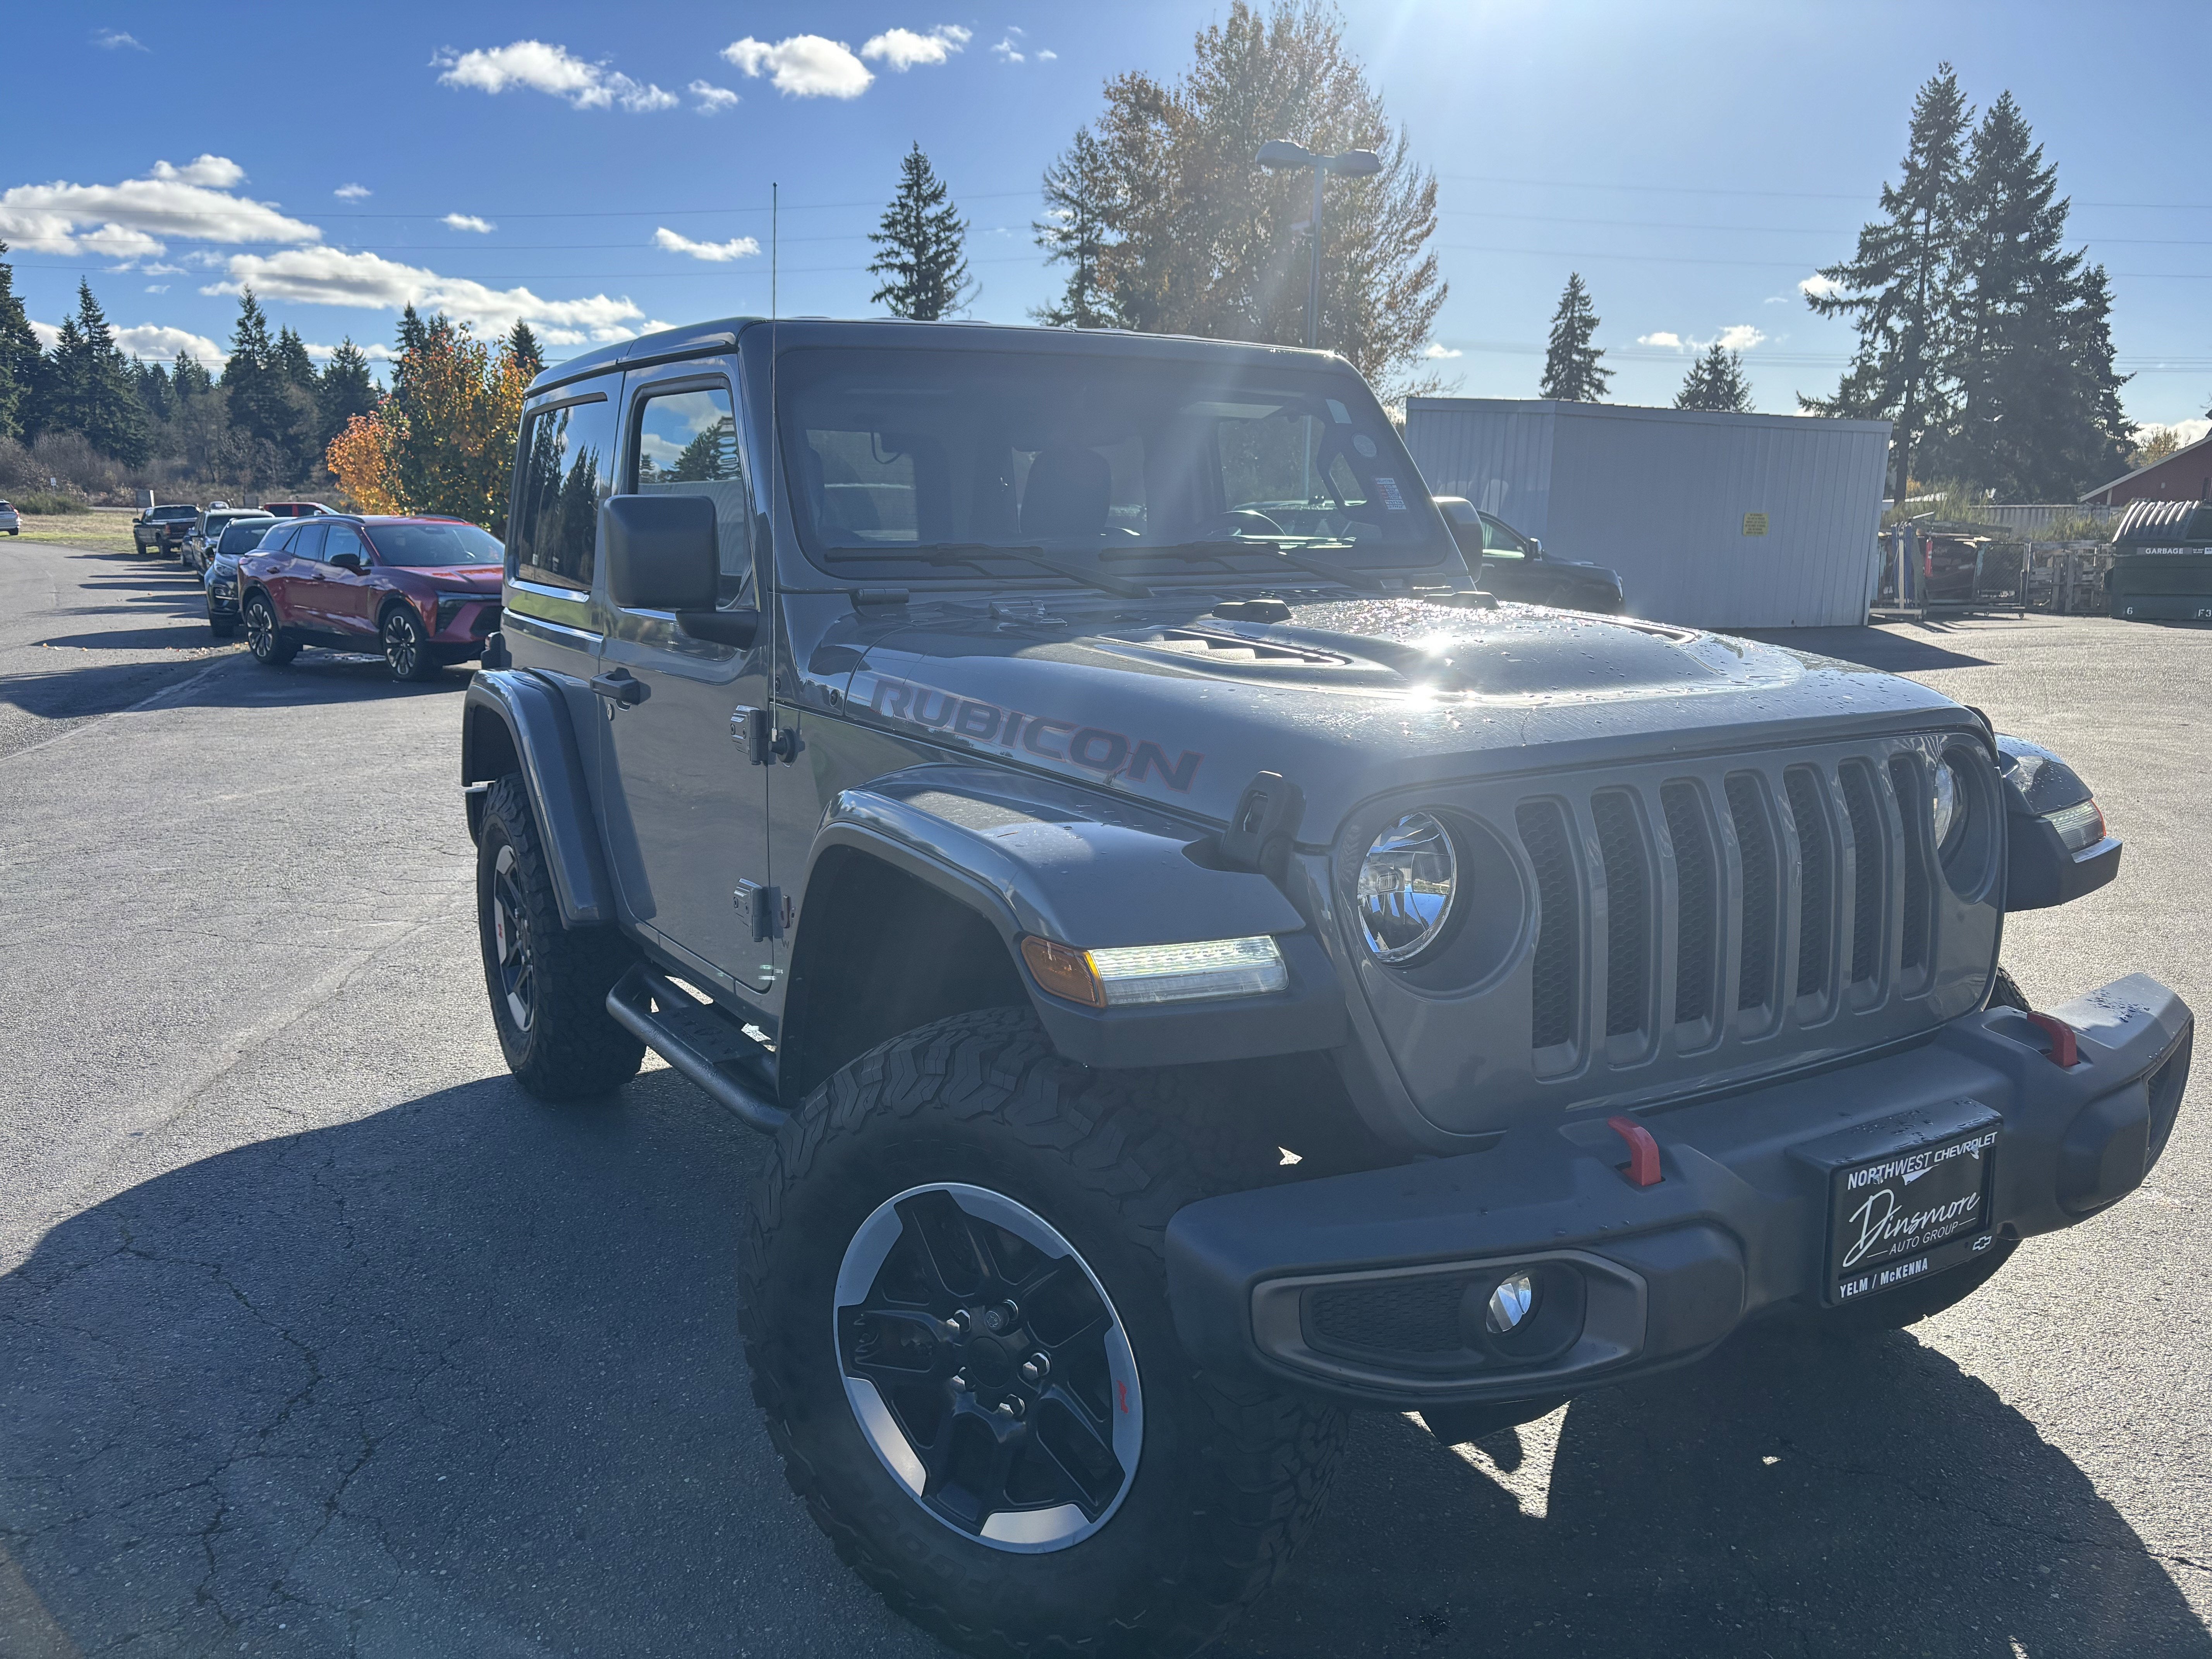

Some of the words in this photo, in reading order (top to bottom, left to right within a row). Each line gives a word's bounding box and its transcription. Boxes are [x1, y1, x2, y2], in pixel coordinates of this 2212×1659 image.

[869, 680, 1205, 795] RUBICON
[1848, 1151, 1932, 1190] NORTHWEST
[1934, 1132, 1998, 1163] CHEVROLET
[1843, 1189, 1980, 1267] Dinsmore
[1889, 1236, 1920, 1255] AUTO
[1923, 1221, 1959, 1243] GROUP
[1840, 1277, 1868, 1298] YELM
[1880, 1258, 1928, 1285] McKENNA
